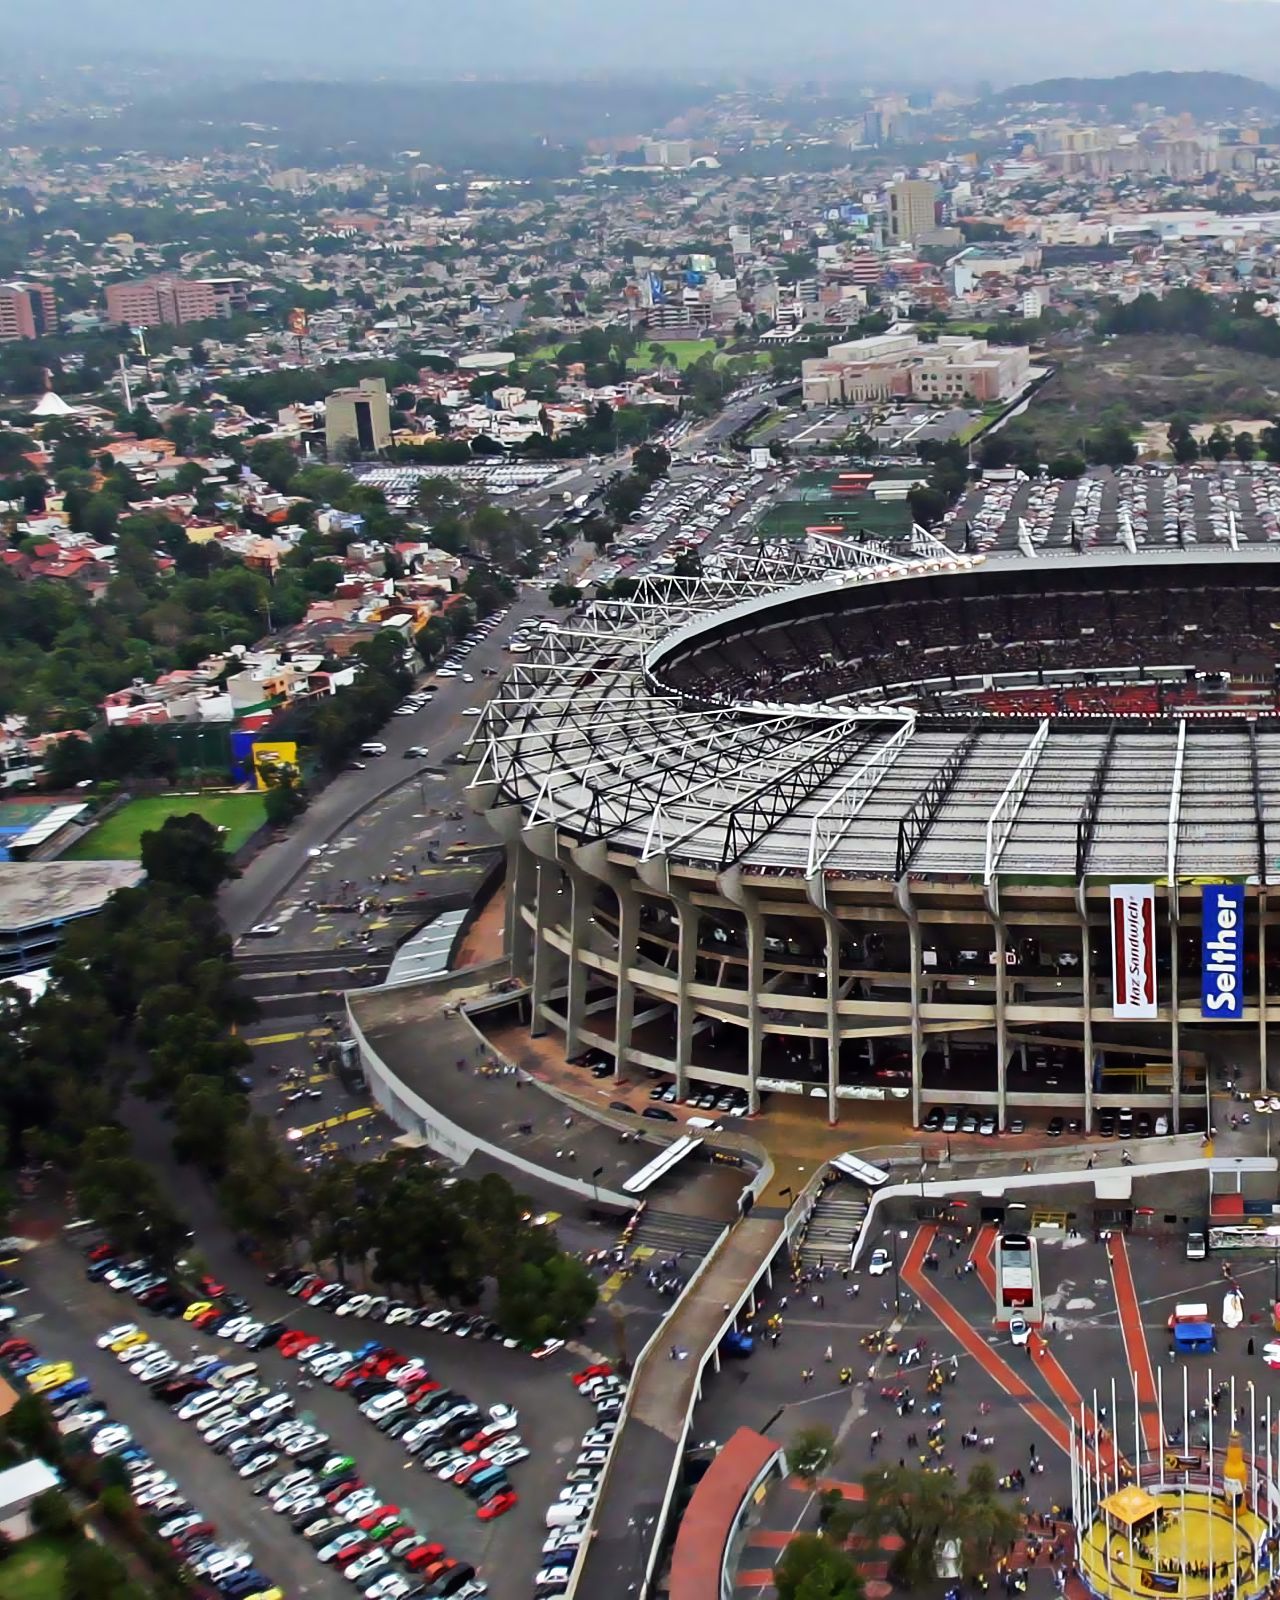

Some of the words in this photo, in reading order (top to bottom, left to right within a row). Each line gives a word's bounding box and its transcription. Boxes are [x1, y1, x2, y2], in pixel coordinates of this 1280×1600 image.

[1128, 901, 1140, 976] Sandwich
[1206, 893, 1237, 1011] Selther
[1129, 978, 1140, 1007] Haz
